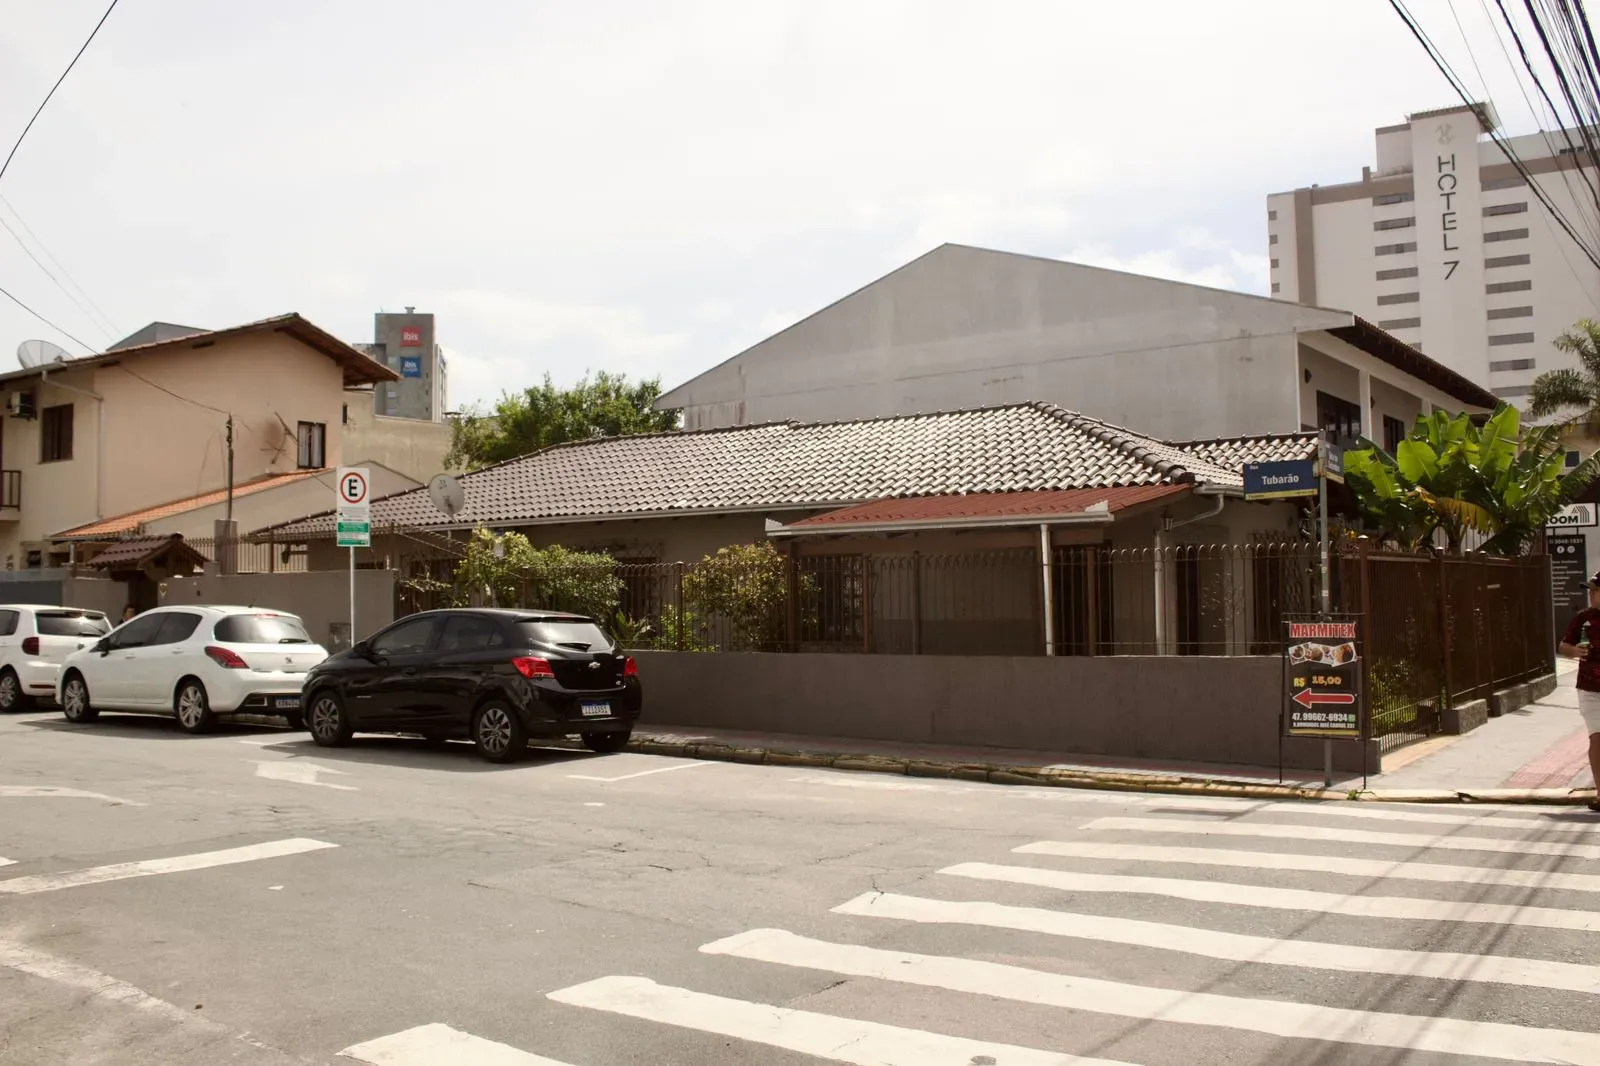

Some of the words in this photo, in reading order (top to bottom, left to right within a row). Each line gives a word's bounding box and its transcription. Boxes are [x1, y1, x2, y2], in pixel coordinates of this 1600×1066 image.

[1437, 153, 1460, 252] HOTEL
[1442, 261, 1460, 280] 7
[403, 331, 418, 341] ibis
[404, 360, 417, 368] ibis
[1261, 474, 1300, 485] Tubarão
[348, 478, 358, 497] E
[1289, 623, 1356, 639] MARMITEX
[1293, 677, 1306, 688] R$
[1311, 675, 1342, 686] 15,00
[1303, 713, 1348, 722] 99662-6934
